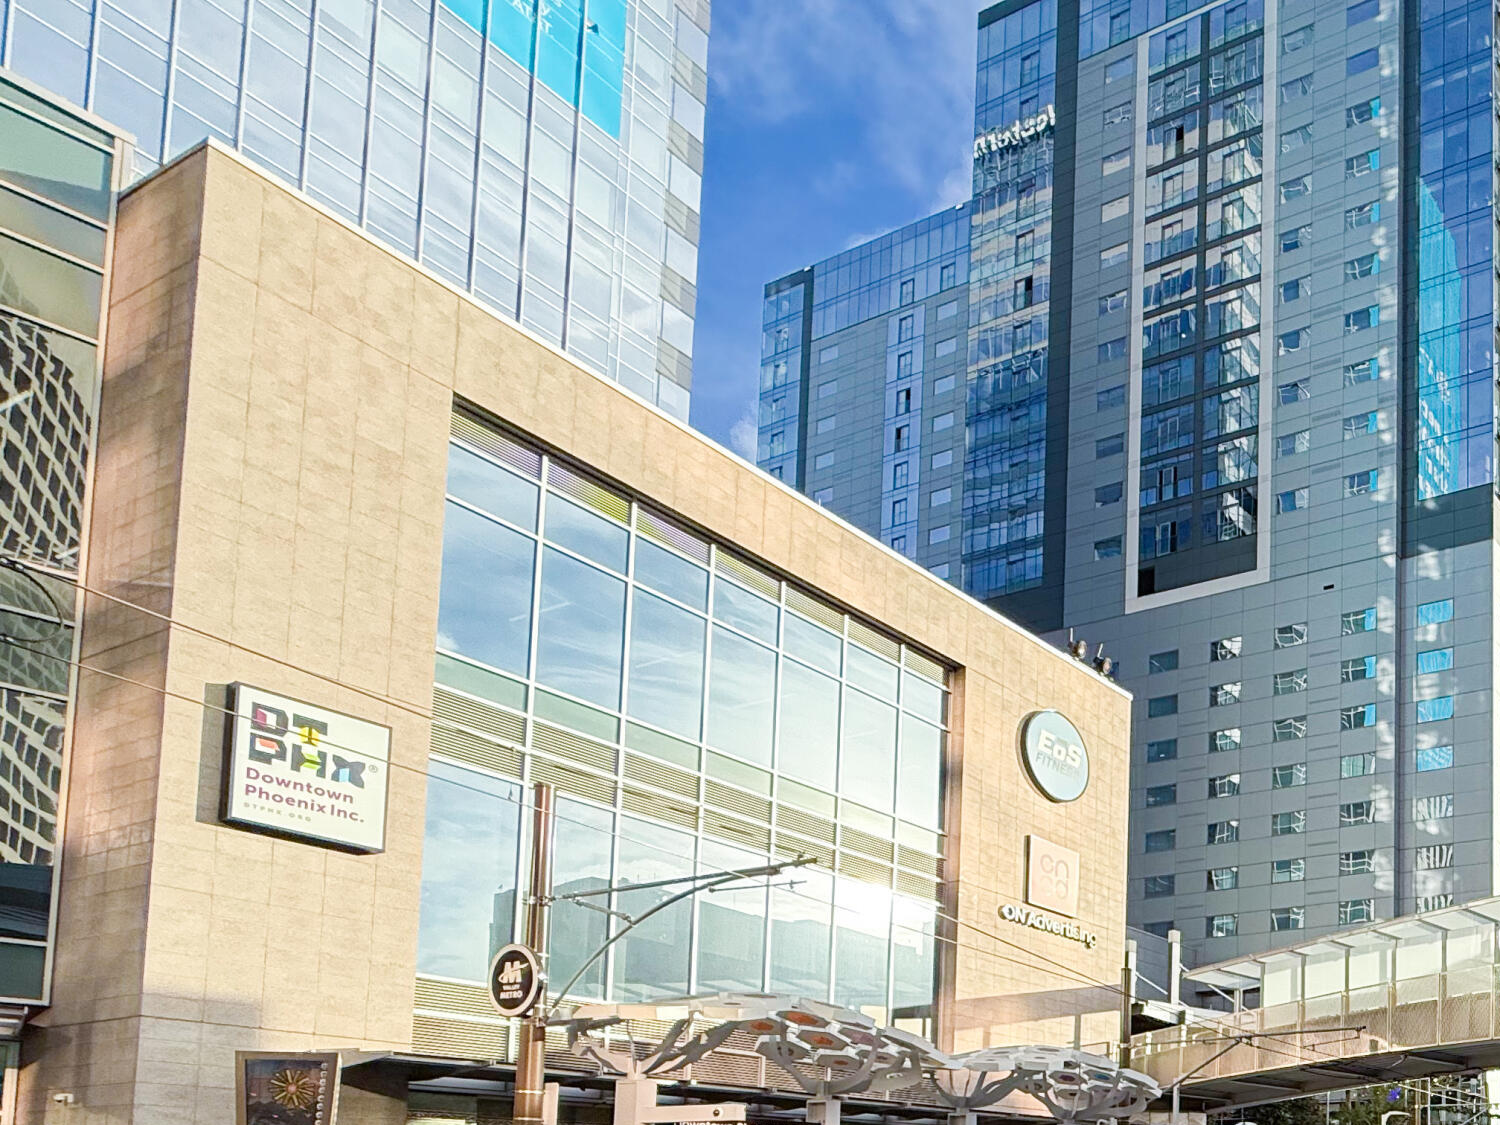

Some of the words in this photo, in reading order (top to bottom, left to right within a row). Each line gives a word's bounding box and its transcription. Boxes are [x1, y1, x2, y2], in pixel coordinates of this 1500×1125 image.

[251, 702, 328, 747] DT
[248, 732, 366, 789] PHX
[245, 783, 326, 814] Phoenix
[330, 804, 365, 823] Inc.
[246, 767, 354, 804] Downtown
[243, 802, 312, 822] DTPHX.ORG
[1000, 904, 1026, 924] ON
[1027, 911, 1096, 949] Advertising
